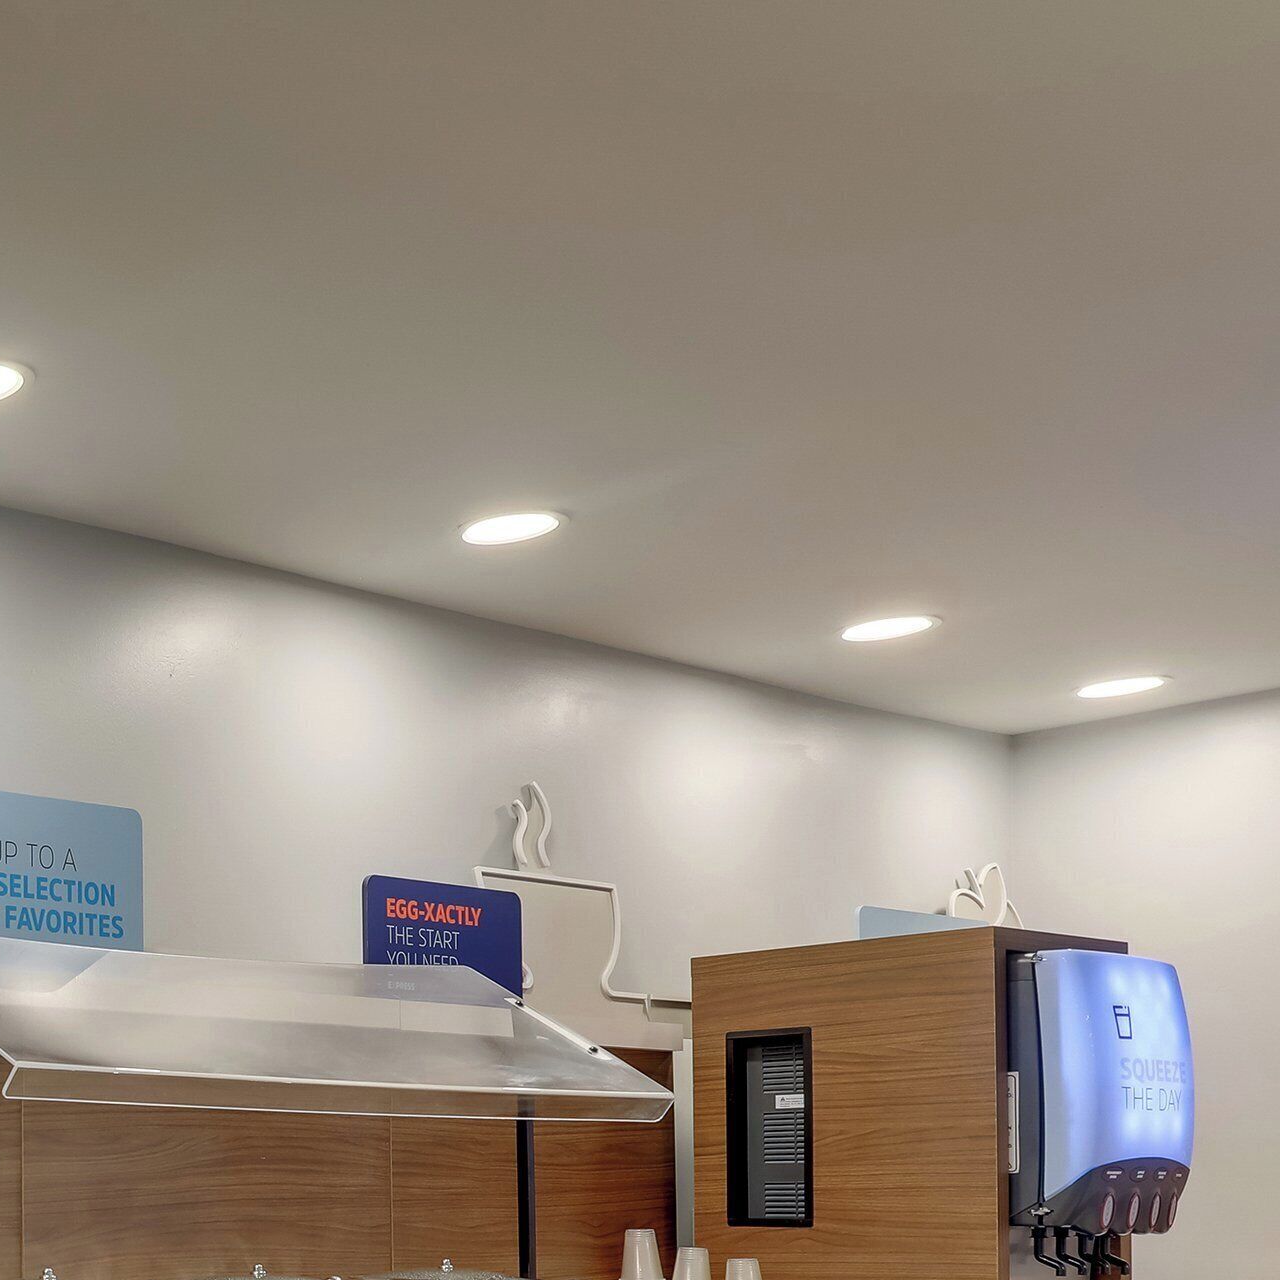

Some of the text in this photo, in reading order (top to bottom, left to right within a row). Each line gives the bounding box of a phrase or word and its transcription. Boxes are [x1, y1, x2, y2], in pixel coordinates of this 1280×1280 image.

[25, 842, 56, 870] TO
[61, 847, 78, 873] A
[4, 904, 126, 940] FAVORITES
[385, 897, 483, 928] EGG-XACTLY
[386, 924, 461, 951] THE START
[386, 950, 415, 965] YOU
[1120, 1056, 1188, 1085] SQUEEZE
[1121, 1085, 1183, 1113] THE DAY
